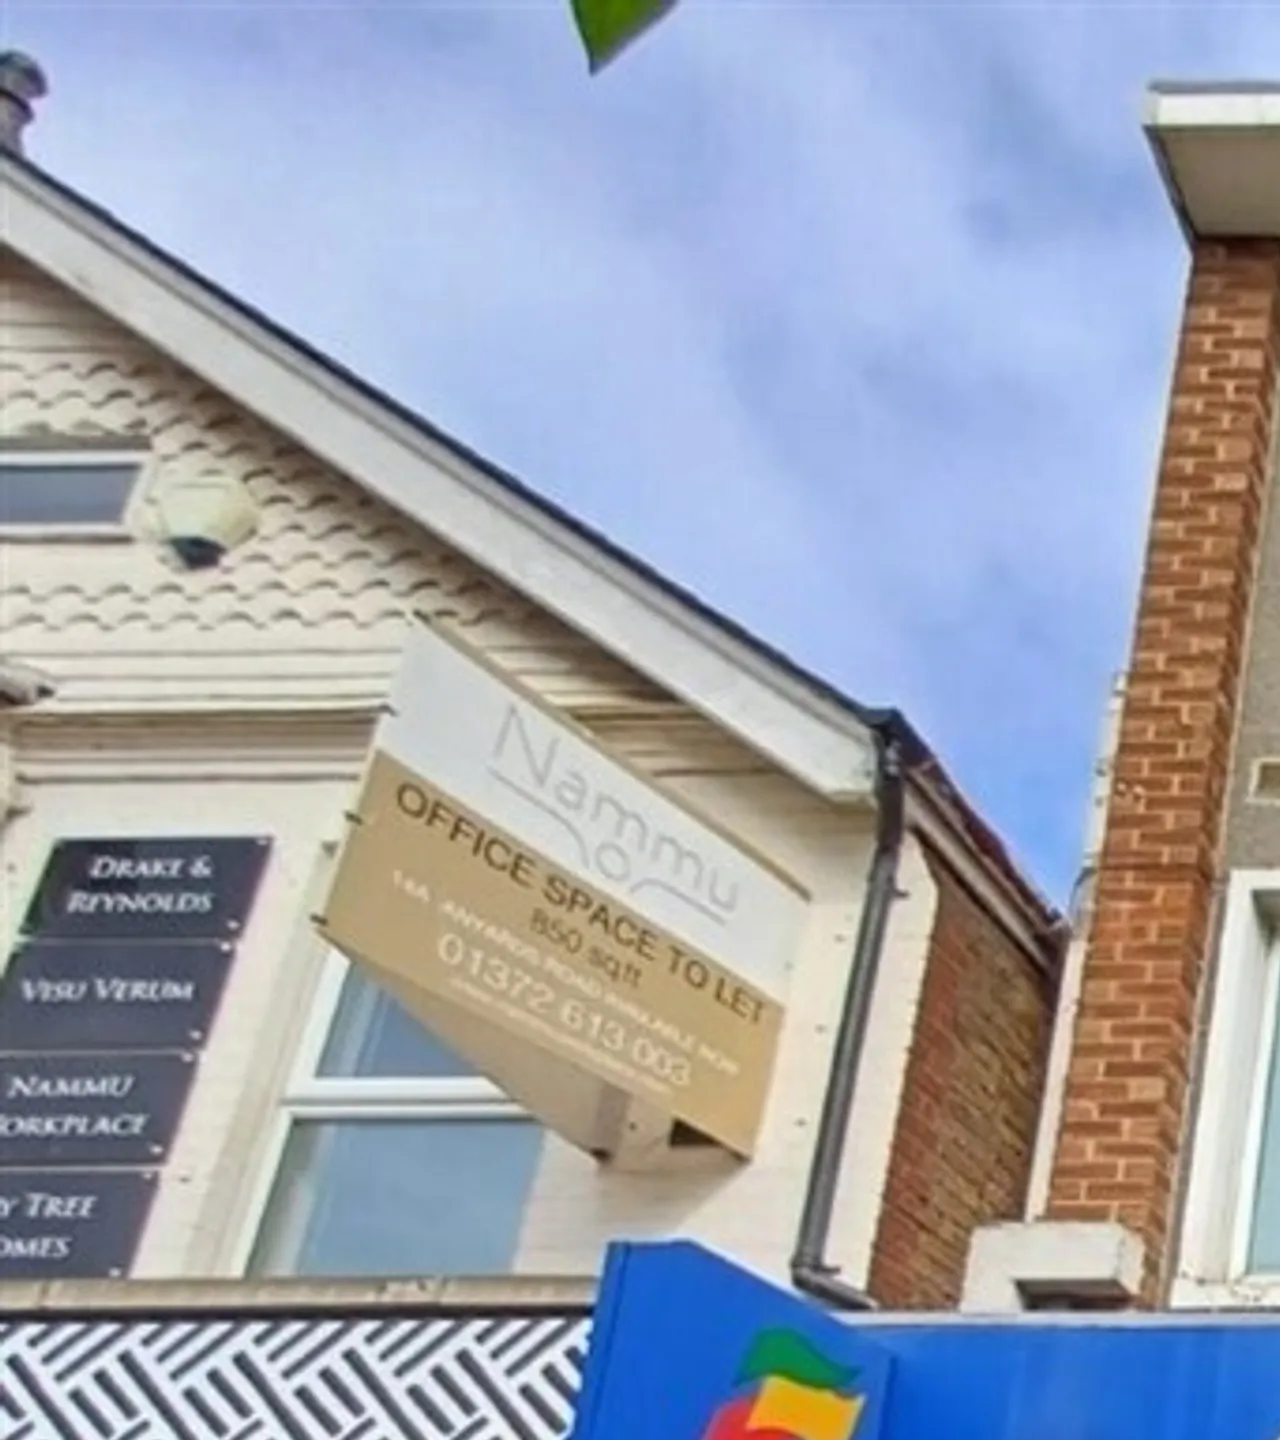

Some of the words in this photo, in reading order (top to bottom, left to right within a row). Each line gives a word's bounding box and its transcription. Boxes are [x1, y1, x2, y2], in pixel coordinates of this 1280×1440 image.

[490, 703, 739, 914] Nammu
[90, 854, 184, 879] DRAKE
[188, 854, 215, 878] &
[66, 890, 216, 914] REYNOLDS
[396, 782, 535, 888] OFFICE
[542, 873, 660, 962] SPACE
[668, 944, 710, 989] TO
[712, 976, 767, 1026] LET
[529, 905, 584, 955] 850
[436, 932, 556, 1014] 01372
[94, 977, 195, 1001] VERUM
[7, 1075, 135, 1098] NAMMU
[0, 1112, 149, 1137] ORKPLACE
[24, 1192, 97, 1218] TREE
[0, 1235, 73, 1258] OMES
